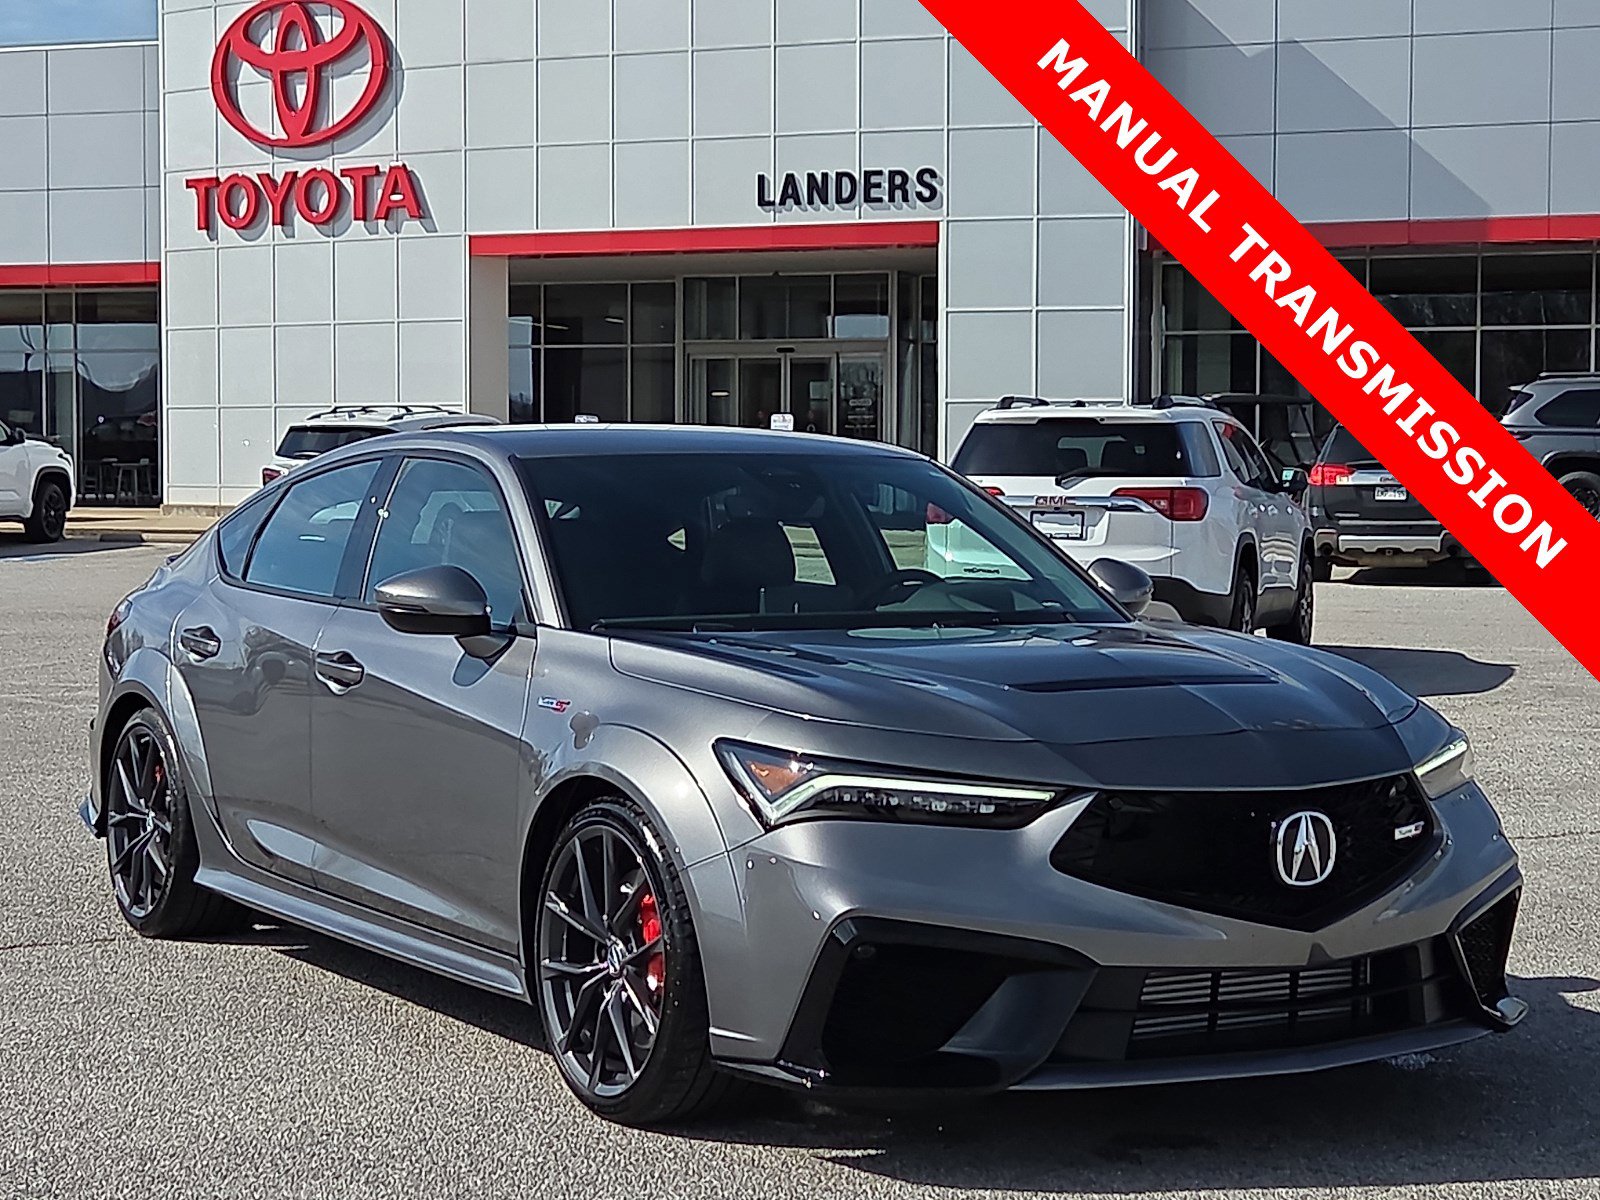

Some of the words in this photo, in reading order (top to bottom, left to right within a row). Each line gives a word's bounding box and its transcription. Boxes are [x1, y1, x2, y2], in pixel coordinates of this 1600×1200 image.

[185, 162, 421, 231] TOYOTA
[756, 167, 939, 207] LANDERS
[1035, 495, 1077, 506] GMC
